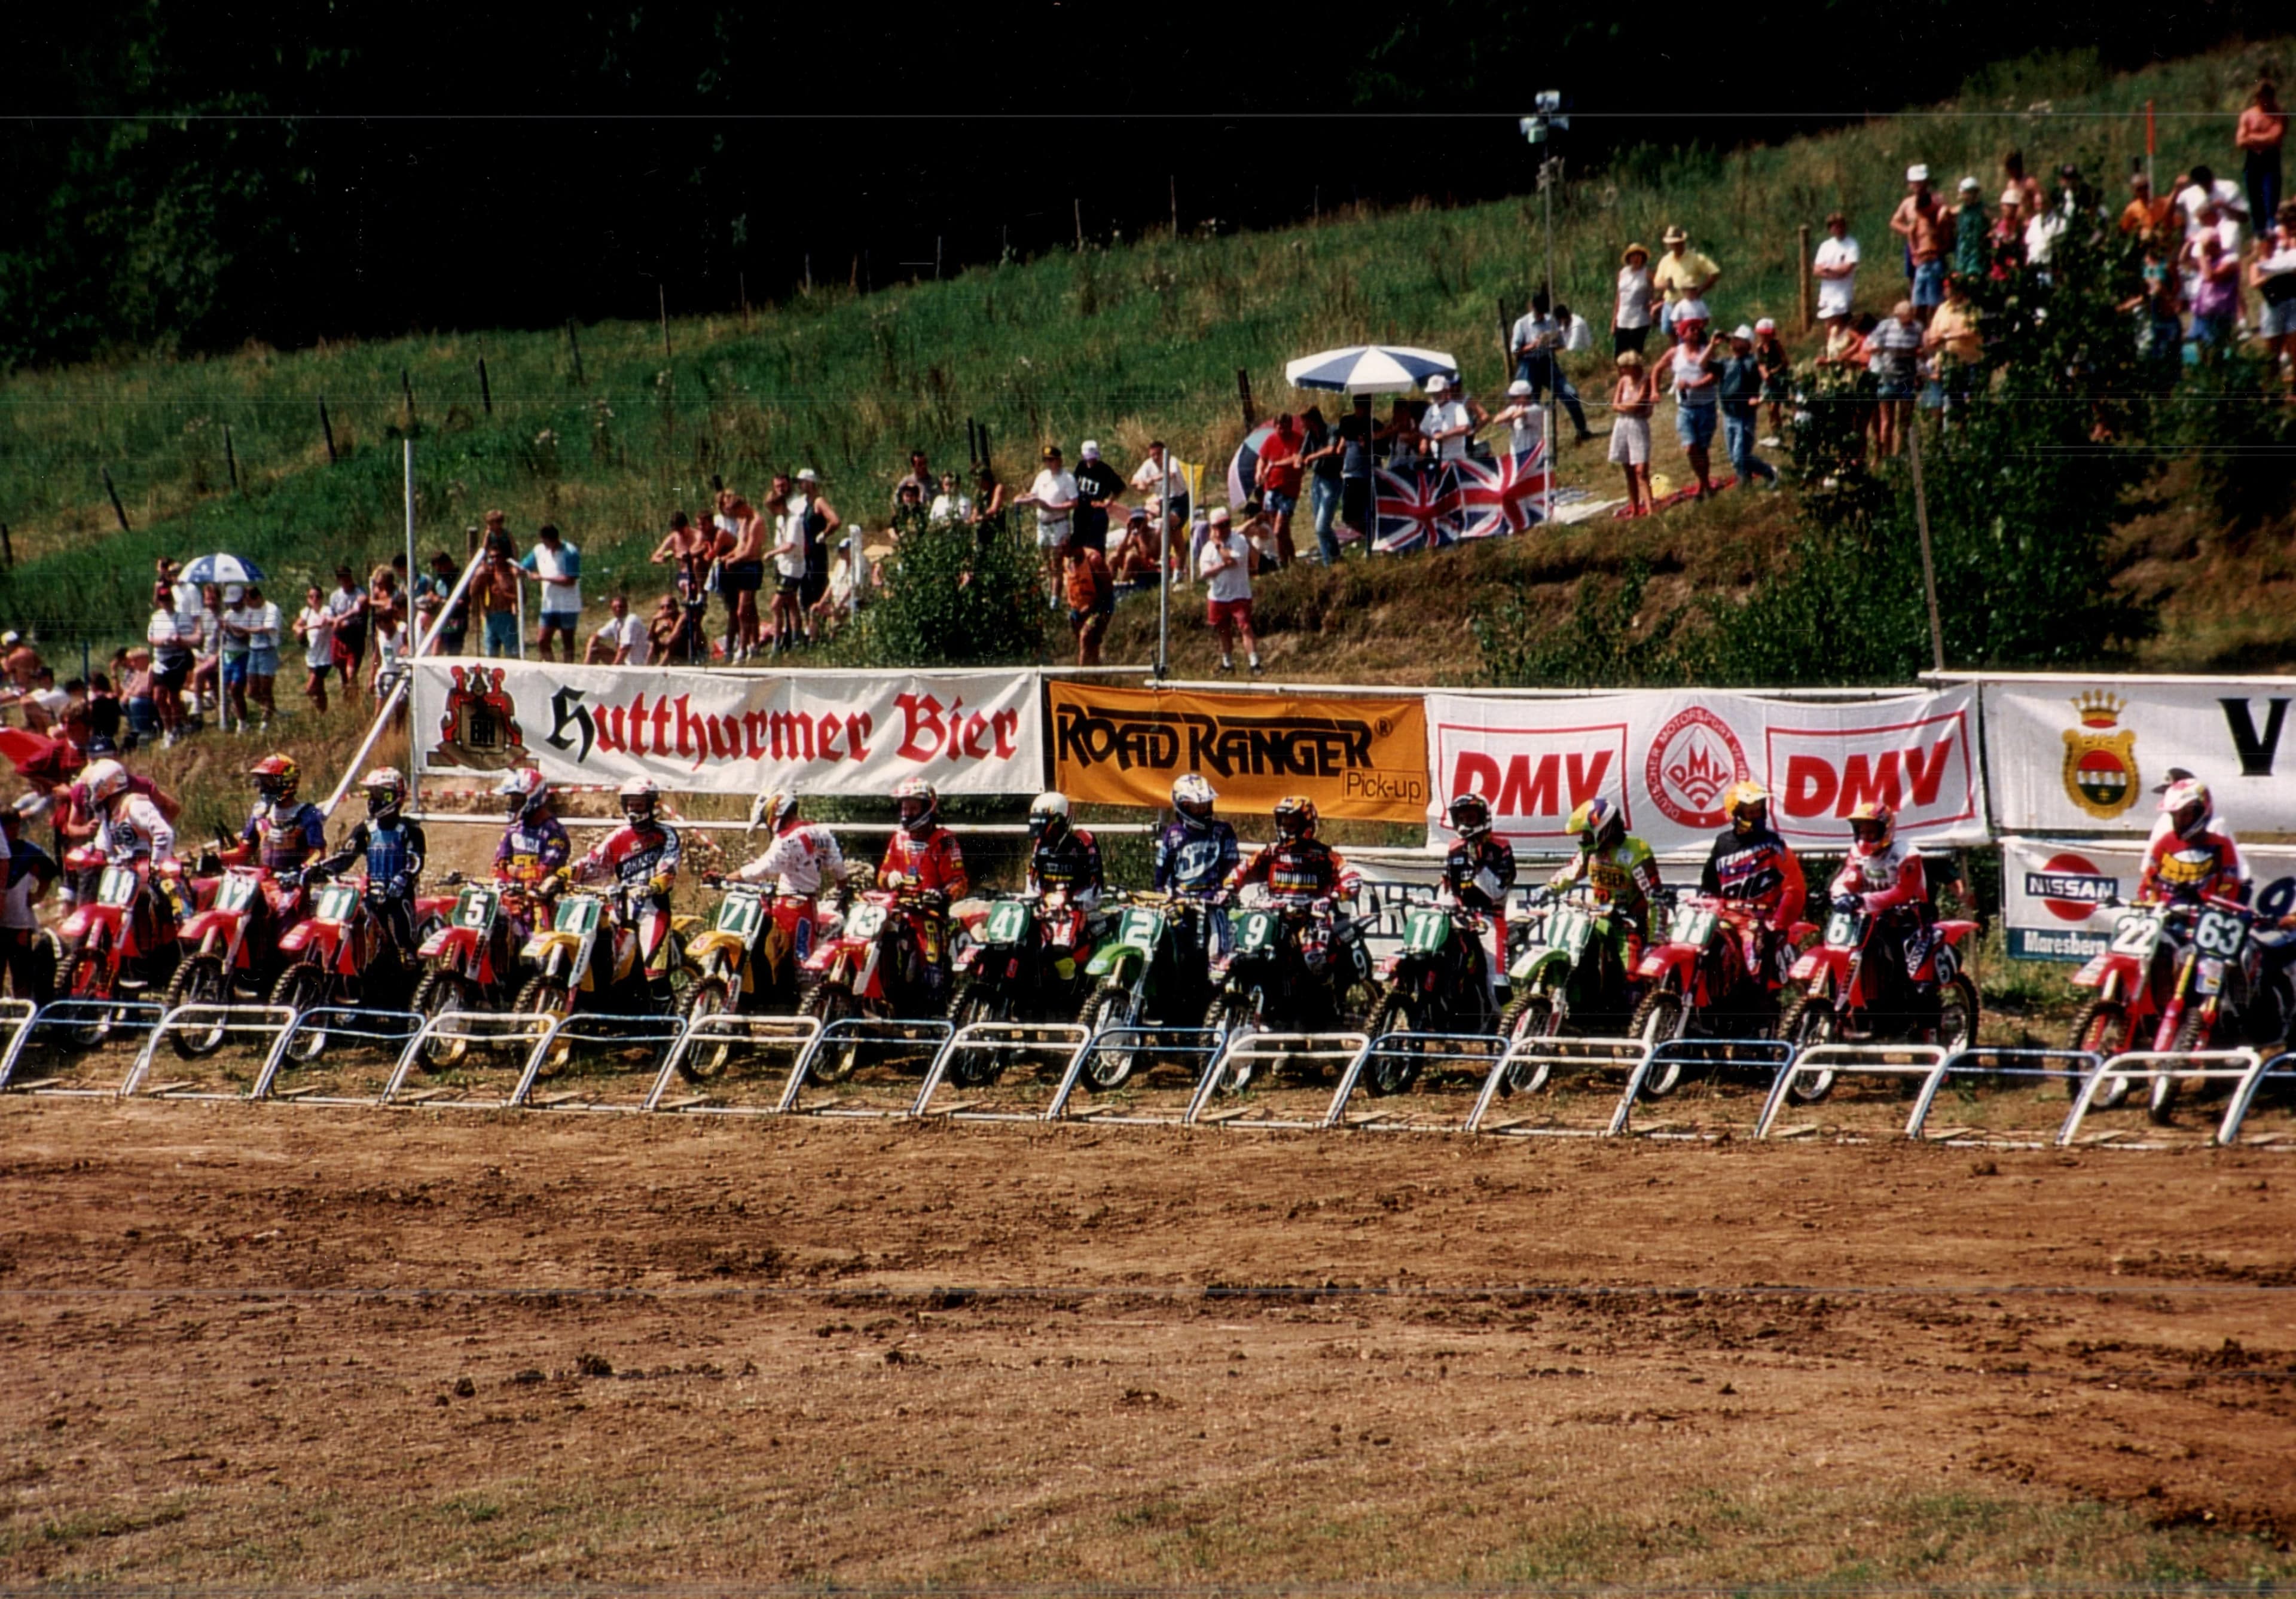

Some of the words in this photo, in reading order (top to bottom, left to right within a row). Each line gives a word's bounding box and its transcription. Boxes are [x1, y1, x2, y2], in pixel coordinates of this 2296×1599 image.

[545, 684, 873, 772] Hutthurmer
[893, 693, 1018, 763] Bier
[1056, 703, 1180, 771] ROAD
[2216, 698, 2292, 776] V
[1668, 743, 1729, 784] DMV
[1784, 736, 1953, 819] DMV
[1346, 771, 1421, 803] Pick-up
[1451, 750, 1614, 817] DMV
[2029, 876, 2114, 900] NISSAN
[464, 893, 488, 927] 5
[564, 901, 588, 934] 4
[721, 897, 758, 933] 71
[844, 904, 887, 937] 13
[990, 906, 1025, 941] 41
[1124, 912, 1153, 947] 2
[1244, 914, 1268, 946] 9
[1412, 913, 1442, 952] 11
[1553, 912, 1588, 948] 14
[1827, 913, 1851, 944] 6
[2112, 916, 2159, 954] 22
[2196, 912, 2245, 955] 63
